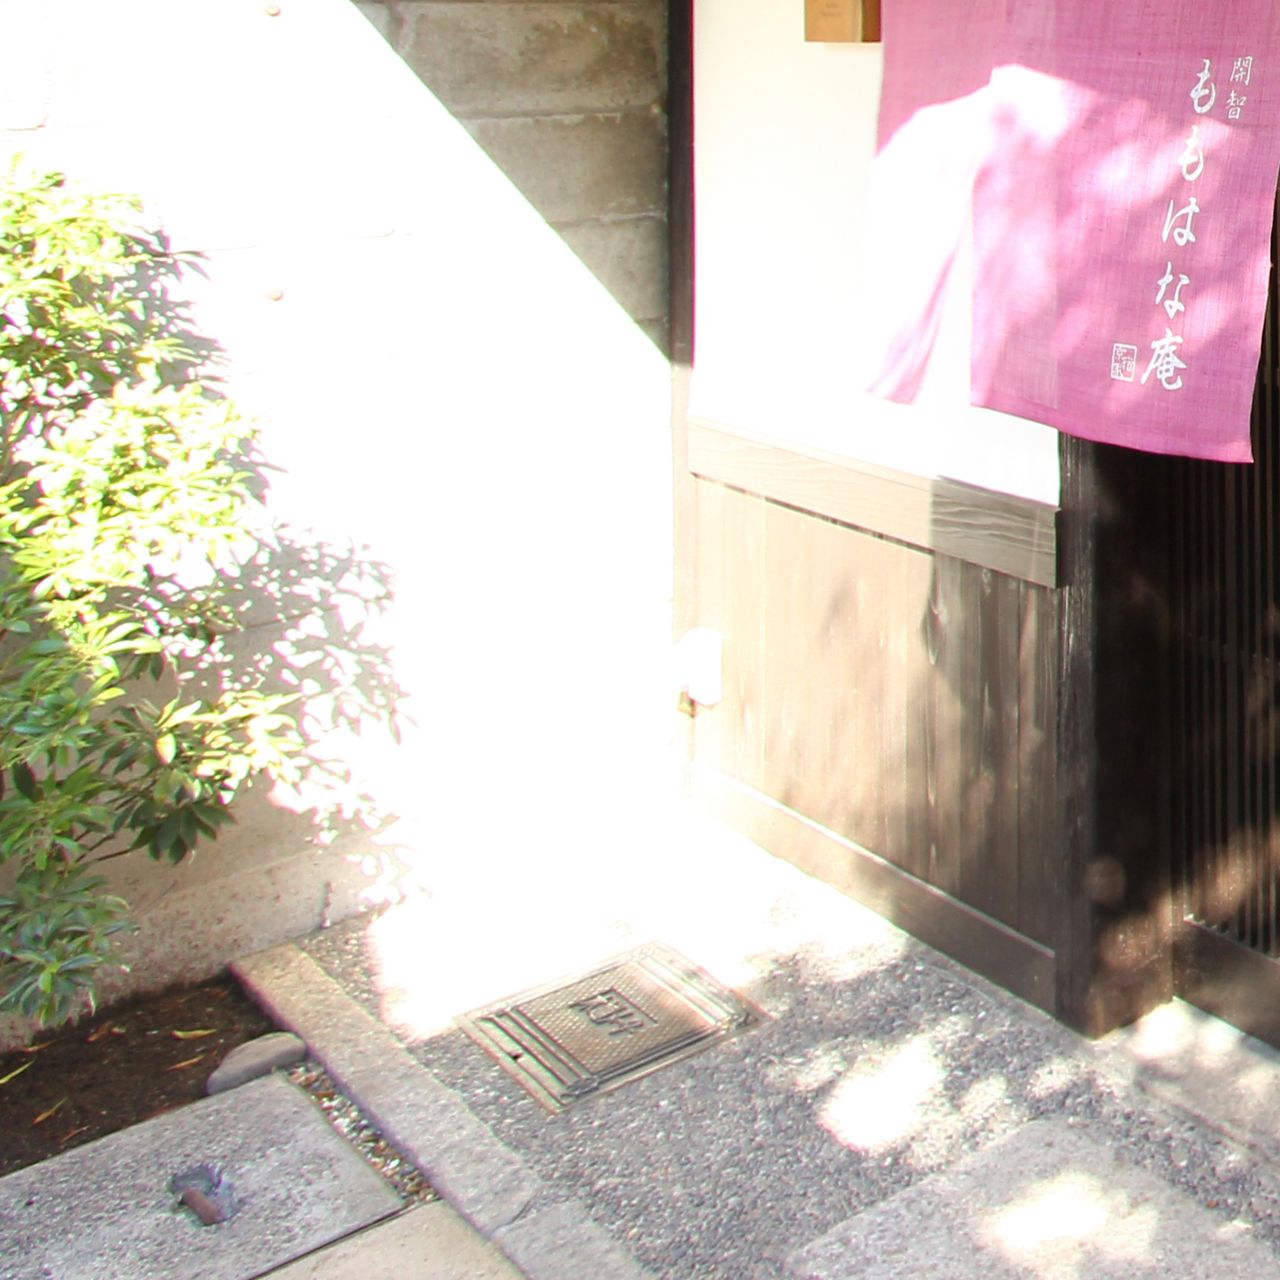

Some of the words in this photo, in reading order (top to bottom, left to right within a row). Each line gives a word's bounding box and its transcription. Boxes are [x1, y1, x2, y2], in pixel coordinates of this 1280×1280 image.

[1226, 55, 1254, 119] 開智
[1140, 58, 1217, 391] ももはな庵
